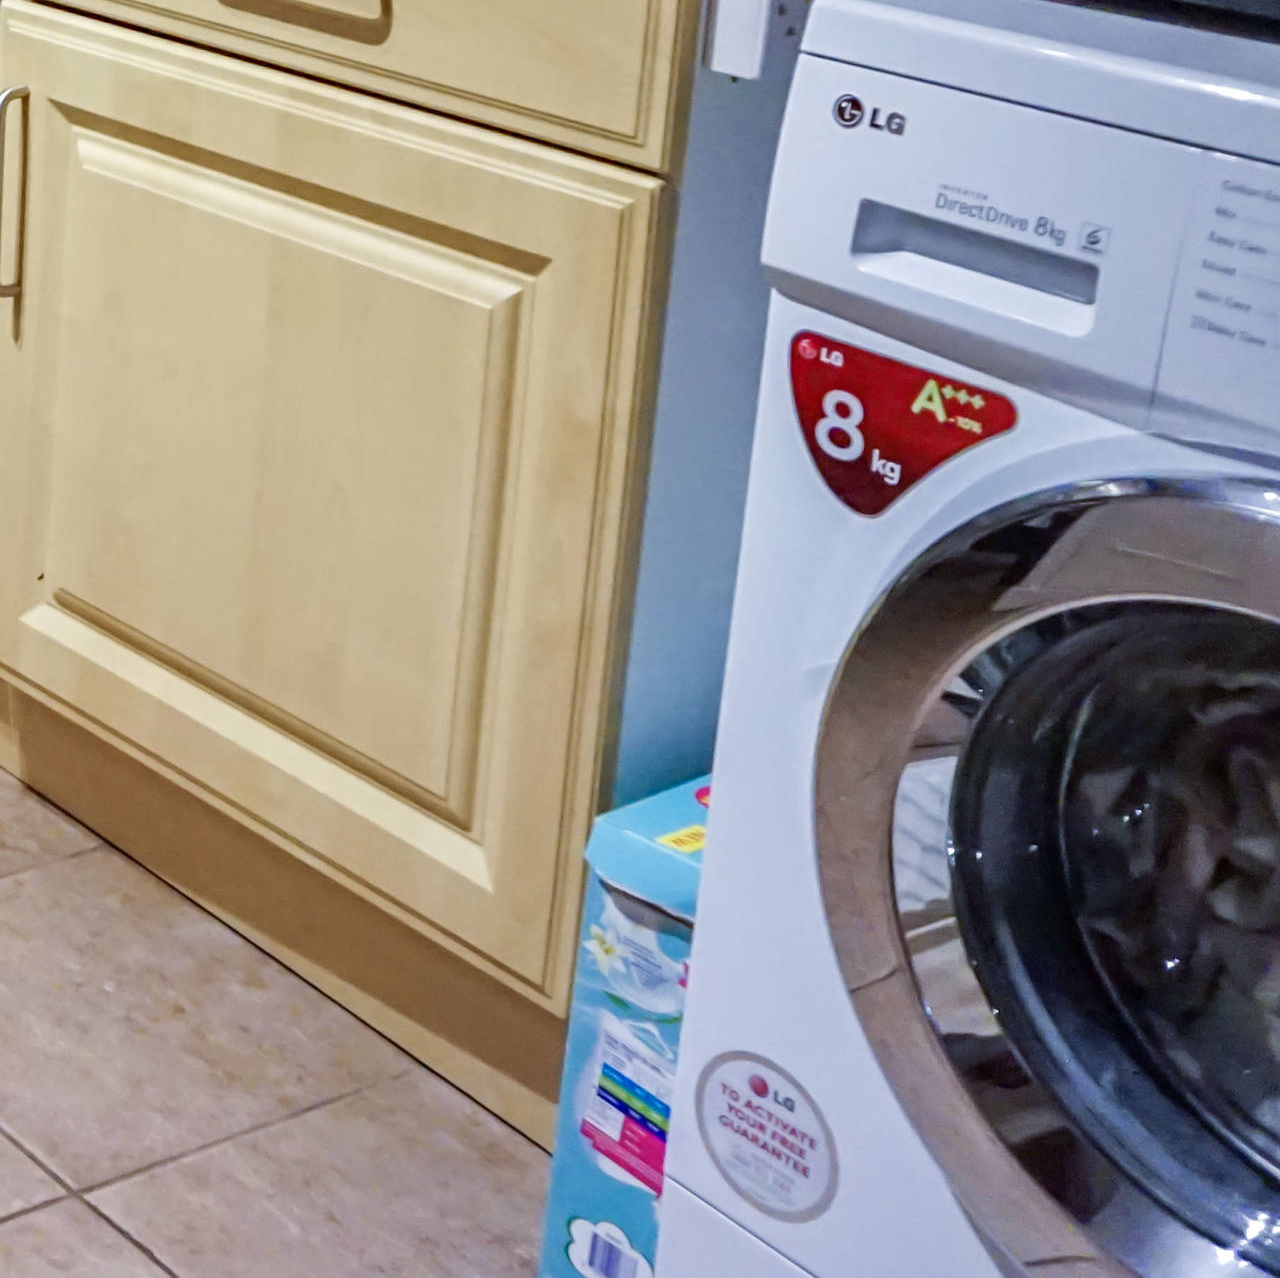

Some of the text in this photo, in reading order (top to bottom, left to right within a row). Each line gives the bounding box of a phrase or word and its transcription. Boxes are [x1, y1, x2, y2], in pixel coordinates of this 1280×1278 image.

[869, 107, 907, 136] LG
[1033, 216, 1067, 246] 8kg
[820, 347, 844, 367] LG
[815, 389, 902, 485] 8 kg
[720, 1082, 817, 1151] TO ACTIVATE
[773, 1089, 796, 1113] LG
[718, 1115, 811, 1179] GUARANTEE
[727, 1102, 807, 1160] YOUR FREE
